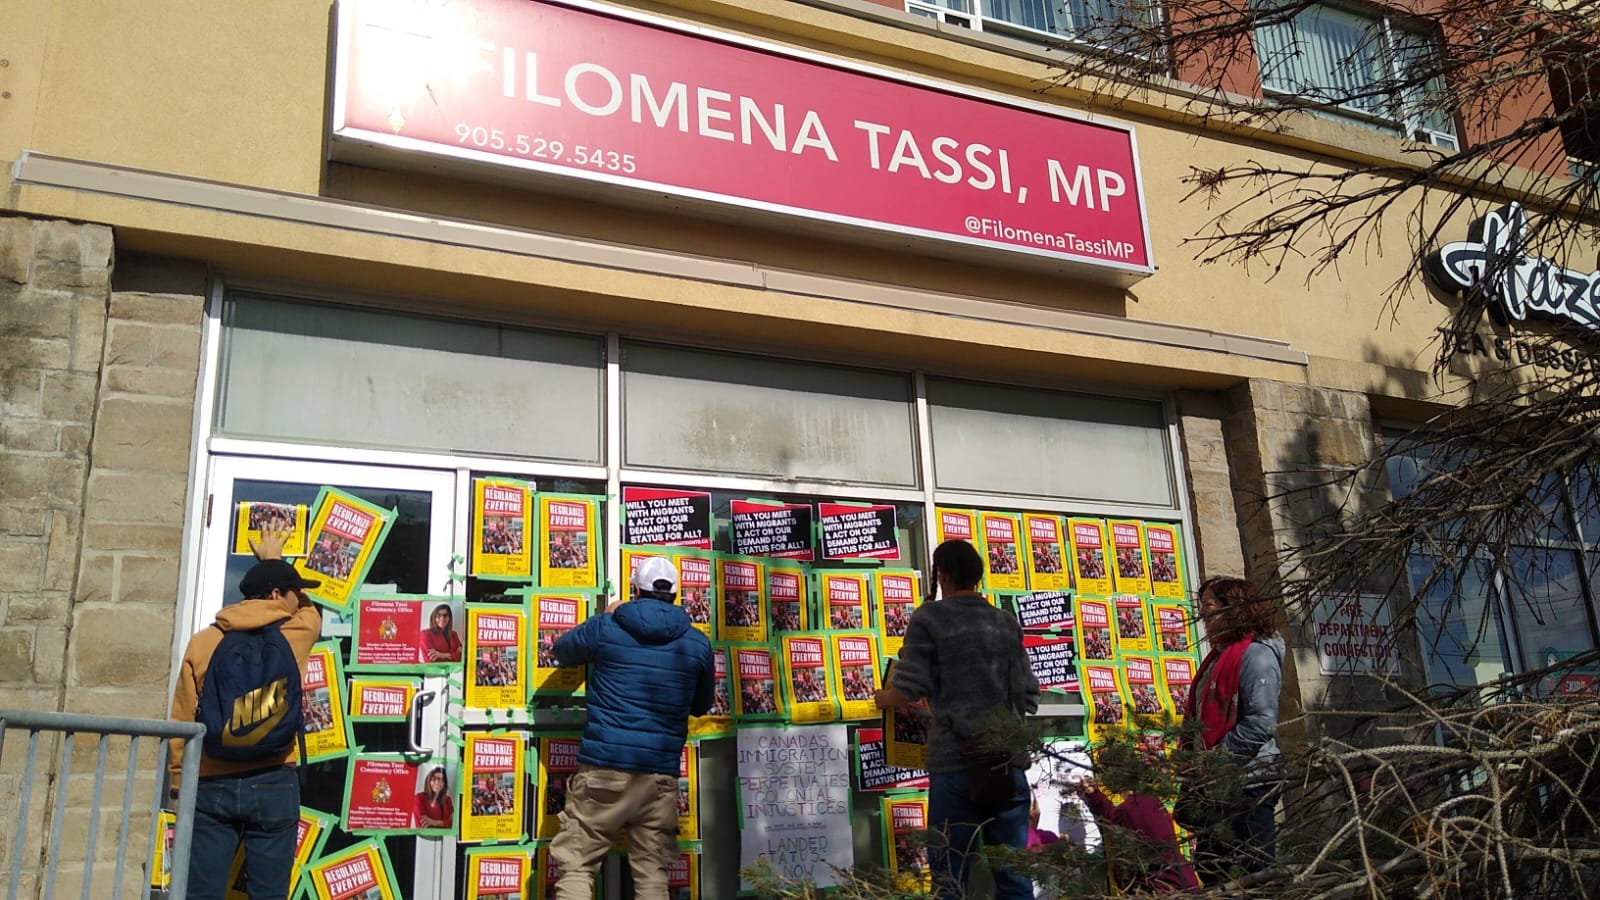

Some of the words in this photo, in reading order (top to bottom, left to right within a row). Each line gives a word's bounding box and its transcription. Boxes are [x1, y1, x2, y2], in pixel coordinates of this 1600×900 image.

[455, 41, 838, 162] FILOMENA
[854, 120, 1028, 204] TASSI,
[1047, 159, 1126, 212] MP
[454, 122, 637, 174] 905.529.5435
[965, 216, 1135, 259] @FilomenaTassiMP
[486, 489, 520, 502] REGULARIZE
[485, 501, 521, 512] EVERYONE
[626, 501, 646, 509] WILL
[668, 498, 689, 506] MEET
[550, 504, 584, 515] REGULARIZE
[627, 510, 649, 518] WITH
[651, 506, 694, 516] MIGRANTS
[772, 510, 791, 518] MEET
[332, 504, 369, 528] REGULARIZE
[550, 515, 584, 526] EVERYONE
[823, 516, 839, 524] WILL
[858, 511, 876, 519] MEET
[327, 515, 367, 538] EVERYONE
[735, 522, 755, 530] WITH
[757, 518, 796, 528] MIGRANTS
[824, 524, 842, 532] WITH
[844, 519, 881, 529] MIGRANTS
[630, 526, 665, 535] DEMAND
[744, 529, 760, 537] ACT
[833, 530, 847, 539] ACT
[631, 533, 663, 543] STATUS
[666, 532, 681, 540] FOR
[684, 530, 701, 538] ALL?
[738, 537, 770, 546] DEMAND
[739, 545, 769, 554] STATUS
[788, 541, 804, 549] ALL?
[827, 538, 858, 547] DEMAND
[829, 546, 857, 555] STATUS
[875, 541, 890, 549] ALL?
[681, 561, 710, 571] REGULARIZ
[725, 565, 754, 576] REGULARIZE
[682, 571, 710, 581] EVERYON
[726, 576, 755, 585] EVERYONE
[771, 576, 796, 587] EGULARIZE
[772, 587, 797, 596] VERYONE
[1018, 595, 1034, 603] WITH
[540, 600, 576, 613] REGULARIZE
[1022, 609, 1048, 617] DEMAND
[1050, 606, 1062, 614] FOR
[479, 617, 515, 629] REGULARIZE
[540, 612, 575, 623] EVERYONE
[1024, 616, 1048, 626] STATUS
[1050, 614, 1062, 622] FOR
[479, 630, 515, 640] EVERYONE
[791, 641, 820, 652] REGULARIZE
[839, 641, 868, 651] REGULARIZE
[1037, 645, 1050, 653] YOU
[1051, 643, 1067, 651] MEET
[792, 652, 821, 662] EVERYONE
[841, 651, 869, 661] EVERYONE
[1039, 651, 1072, 661] MIGRANTS
[363, 690, 403, 703] REGULARIZE
[232, 677, 288, 731] NIKE
[362, 704, 403, 714] EVERYONE
[475, 742, 513, 755] REGULARIZE
[859, 743, 878, 752] WILL
[475, 755, 513, 766] EVERYONE
[739, 748, 847, 763] IMMIGRATION
[861, 751, 880, 761] WITH
[765, 761, 825, 775] SYSTEM
[864, 767, 895, 778] DEMAND
[739, 774, 849, 790] PERPETUATES
[866, 775, 895, 787] STATUS
[896, 772, 911, 780] FOR
[913, 769, 928, 777] ALL
[756, 788, 832, 803] COLONIAL
[747, 801, 846, 818] INJUSTICES
[768, 836, 828, 853] LANDED
[324, 860, 368, 883] REGULARIZE
[480, 862, 520, 874] REGULARIZE
[784, 864, 814, 878] NOW
[330, 871, 372, 896] EVERYONE
[479, 875, 519, 887] EVERYONE
